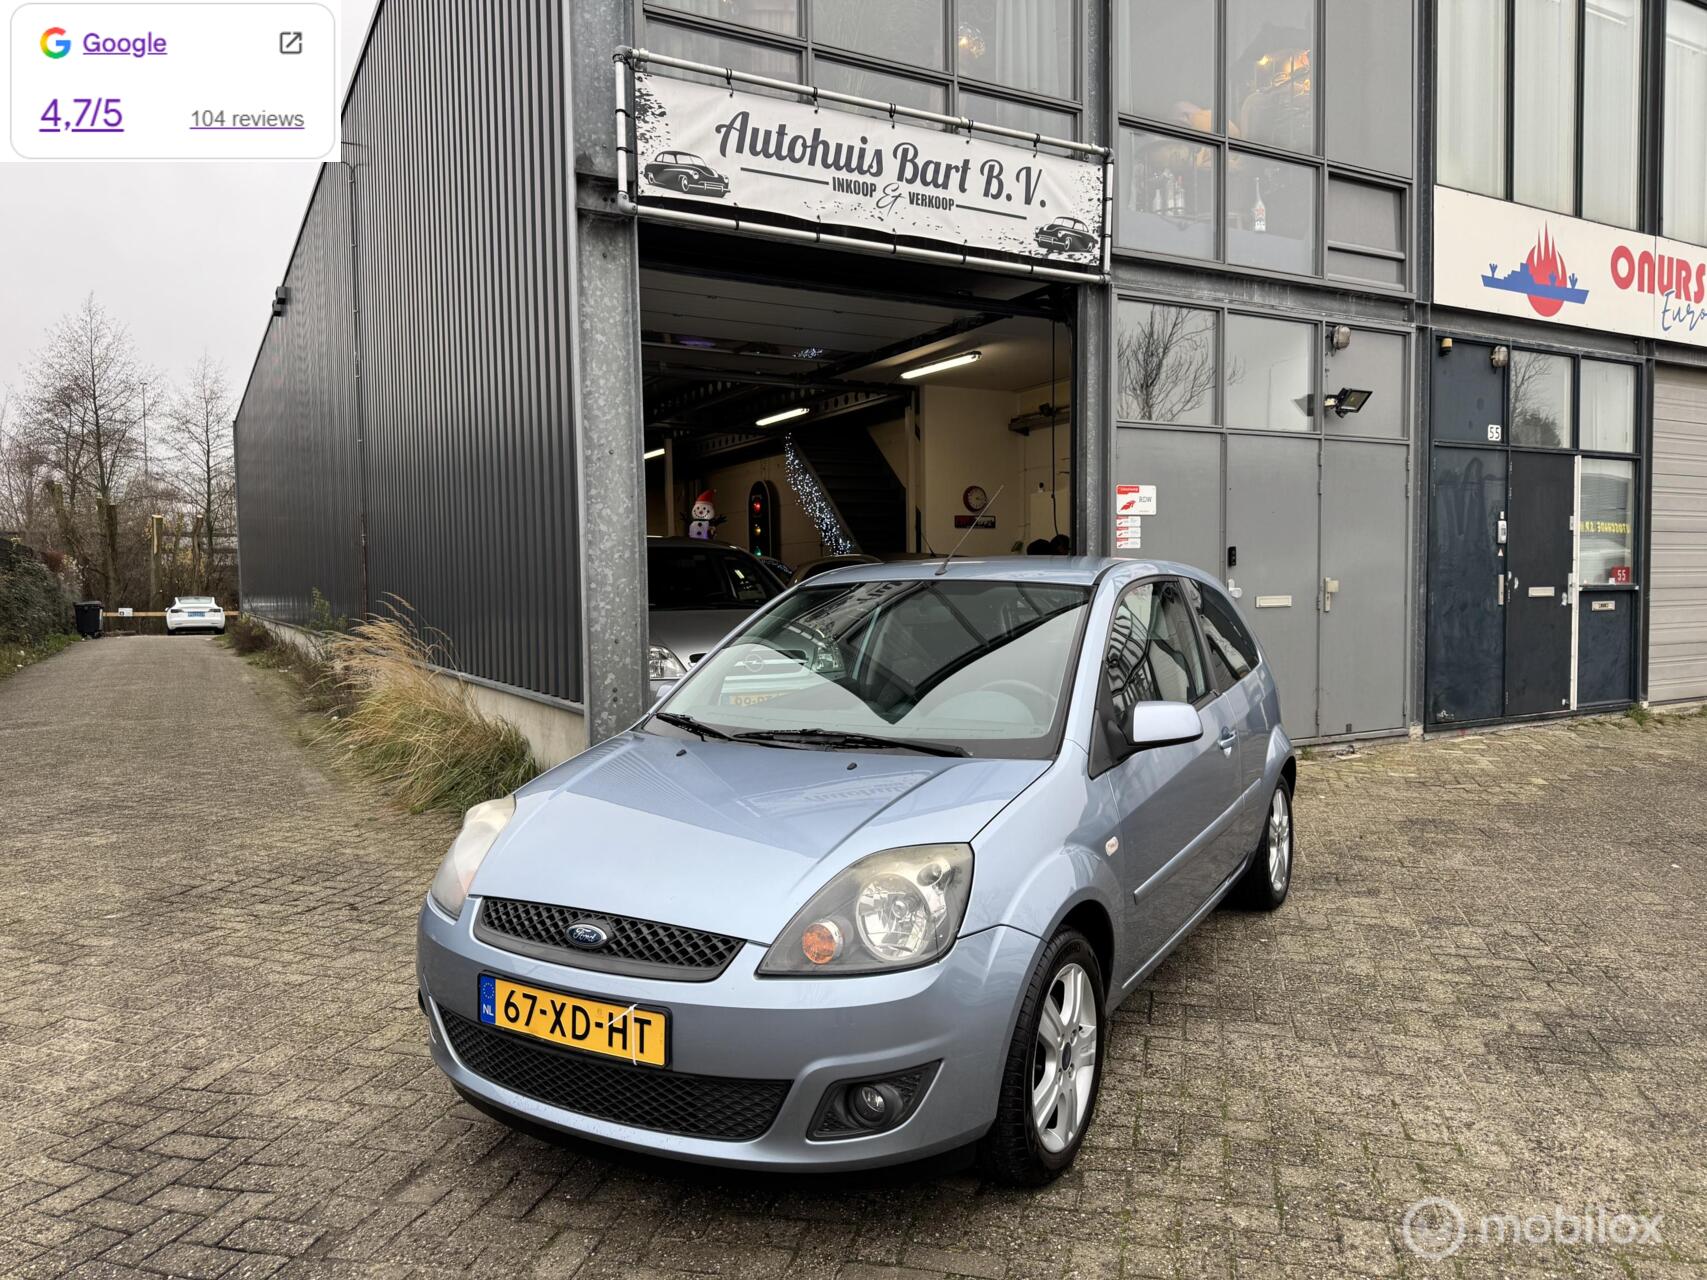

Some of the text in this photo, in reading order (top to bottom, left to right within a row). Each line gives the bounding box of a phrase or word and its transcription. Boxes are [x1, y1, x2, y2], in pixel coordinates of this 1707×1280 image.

[715, 110, 1047, 208] Autohuis Bart B.V.
[831, 175, 877, 199] INKOOP
[908, 190, 957, 212] VERKOOP
[1489, 427, 1500, 439] 55
[1617, 569, 1626, 582] 55
[574, 927, 596, 942] Ford
[482, 990, 651, 1053] NL 67-XD-HT
